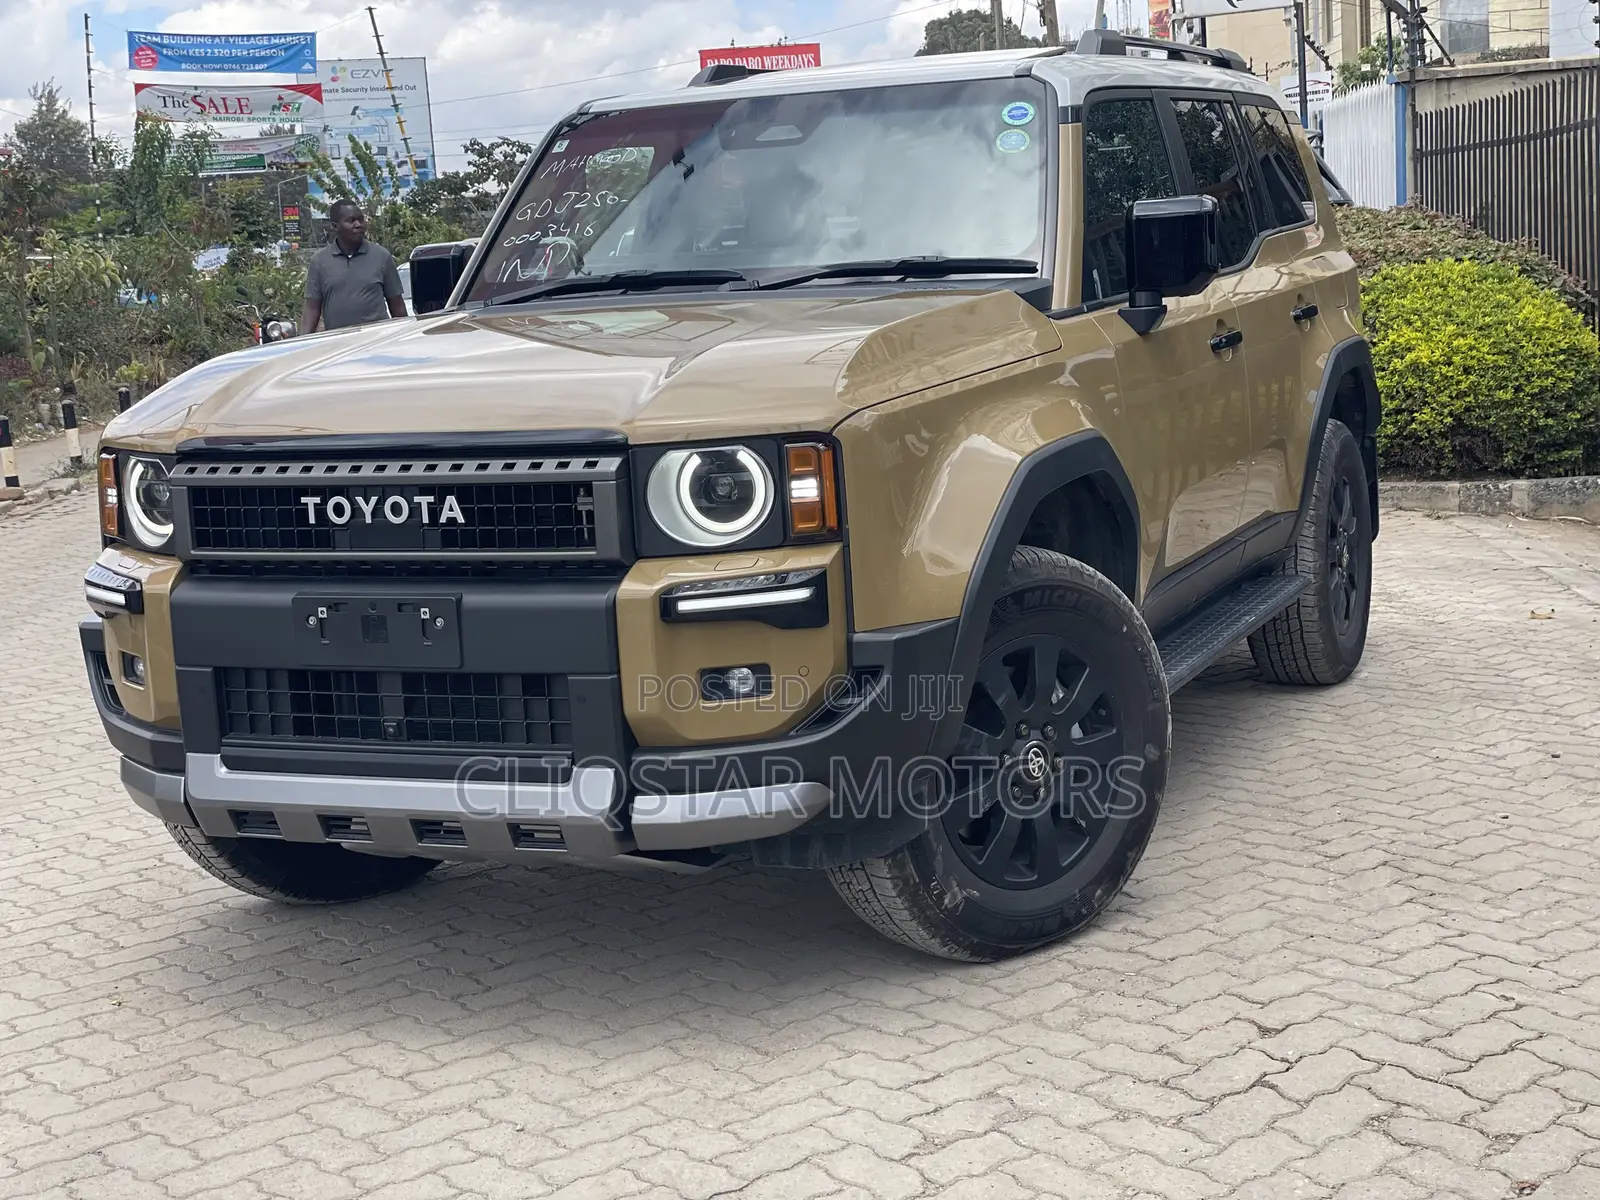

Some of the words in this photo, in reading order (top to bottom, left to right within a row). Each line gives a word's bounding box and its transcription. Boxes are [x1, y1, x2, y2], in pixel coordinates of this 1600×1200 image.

[134, 34, 161, 43] TEAM
[163, 35, 212, 44] BUILDING
[213, 36, 227, 44] AT
[228, 36, 269, 44] VILLAGE
[270, 35, 313, 44] MARKET
[163, 48, 188, 56] FROM
[189, 48, 205, 57] KES
[231, 49, 249, 57] PER
[250, 49, 285, 57] PERSON
[763, 53, 815, 70] WEEKDAYS
[340, 86, 368, 94] Security
[157, 95, 190, 109] The
[190, 94, 253, 115] SALE
[270, 101, 303, 113] NSH
[283, 206, 299, 216] 3M
[503, 220, 597, 247] 0003416
[300, 495, 466, 525] TOYOTA
